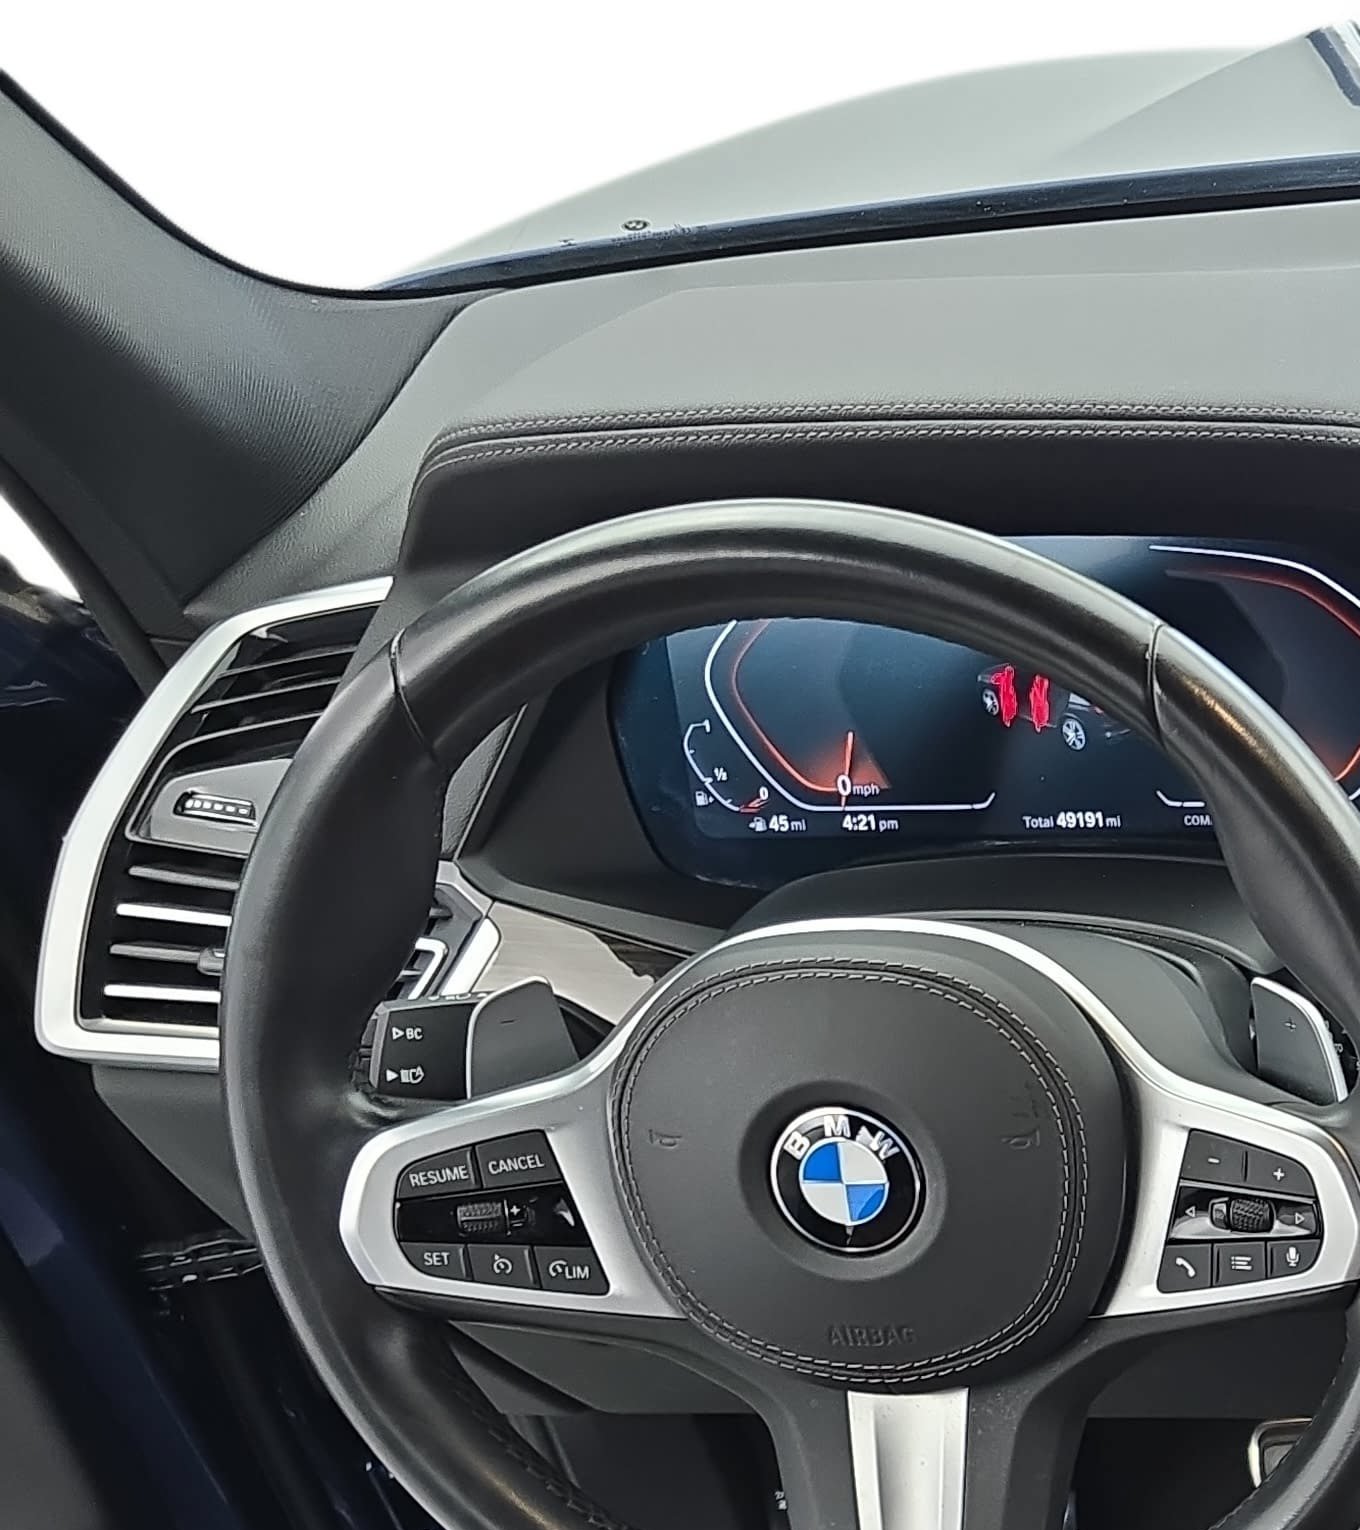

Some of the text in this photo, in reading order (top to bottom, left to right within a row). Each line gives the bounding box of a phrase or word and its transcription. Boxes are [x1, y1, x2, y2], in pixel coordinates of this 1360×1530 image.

[837, 774, 880, 797] 0 mph
[768, 813, 806, 832] 45 mi
[842, 813, 899, 832] 4:21 pm
[1022, 811, 1121, 829] Total 49191 mi
[405, 1026, 423, 1040] BC
[783, 1115, 900, 1161] BMW
[488, 1153, 545, 1175] CANCEL
[409, 1164, 469, 1188] RESUME
[423, 1251, 450, 1266] SET
[565, 1264, 590, 1280] LIM
